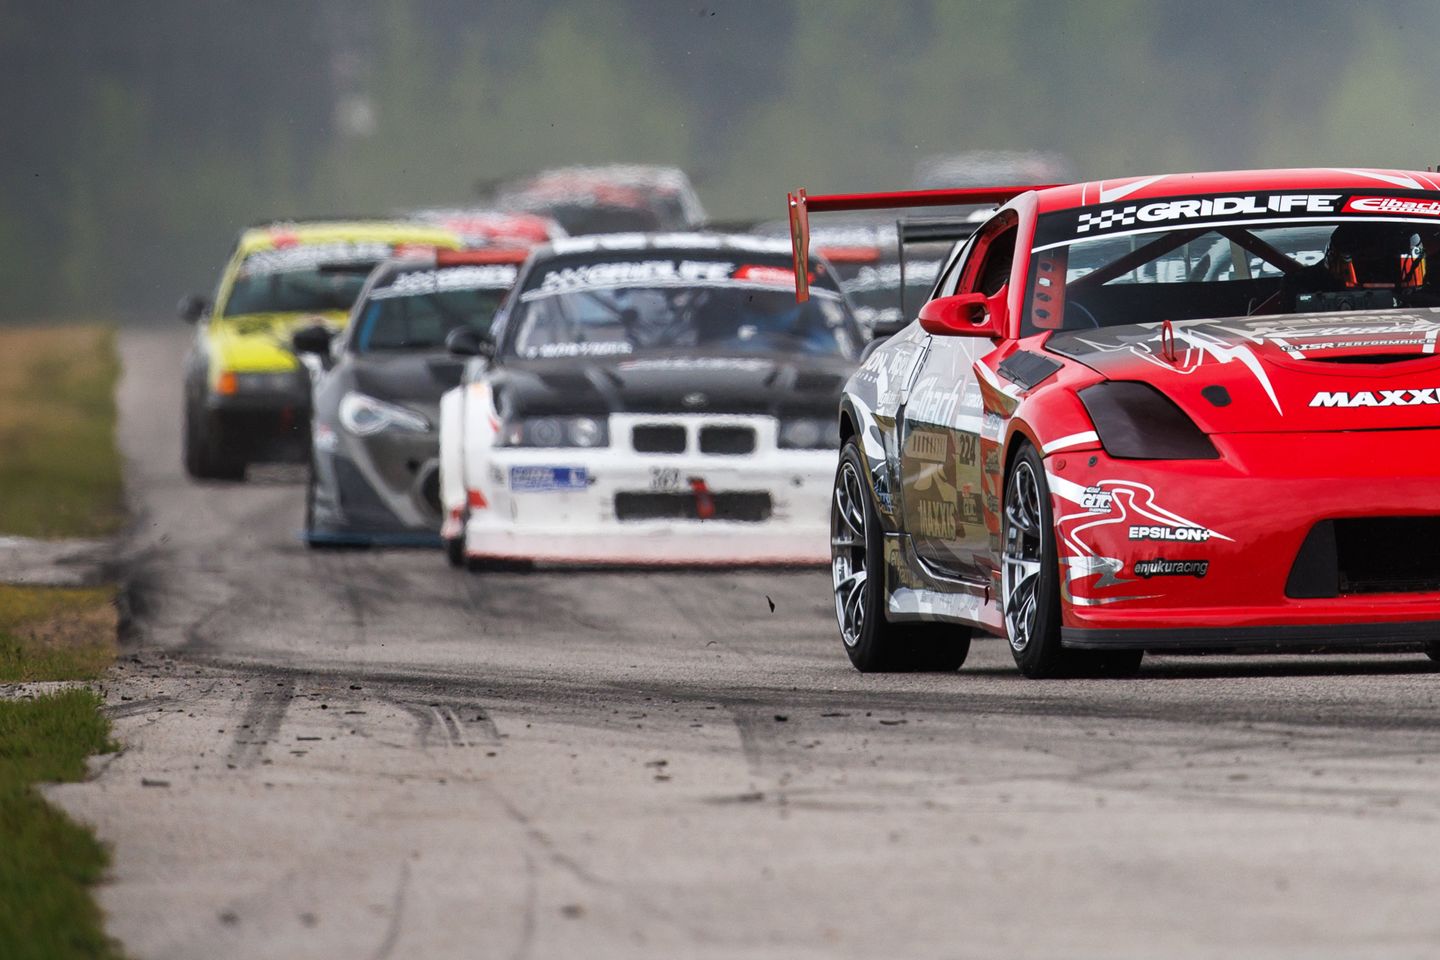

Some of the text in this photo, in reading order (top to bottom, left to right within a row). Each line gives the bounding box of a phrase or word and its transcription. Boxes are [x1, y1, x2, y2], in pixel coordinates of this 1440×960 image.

[1136, 194, 1342, 222] GRIDLIFE
[1337, 338, 1437, 350] PERFORMANCE
[1128, 526, 1212, 541] EPSILON+
[1133, 559, 1209, 577] enjukuracing
